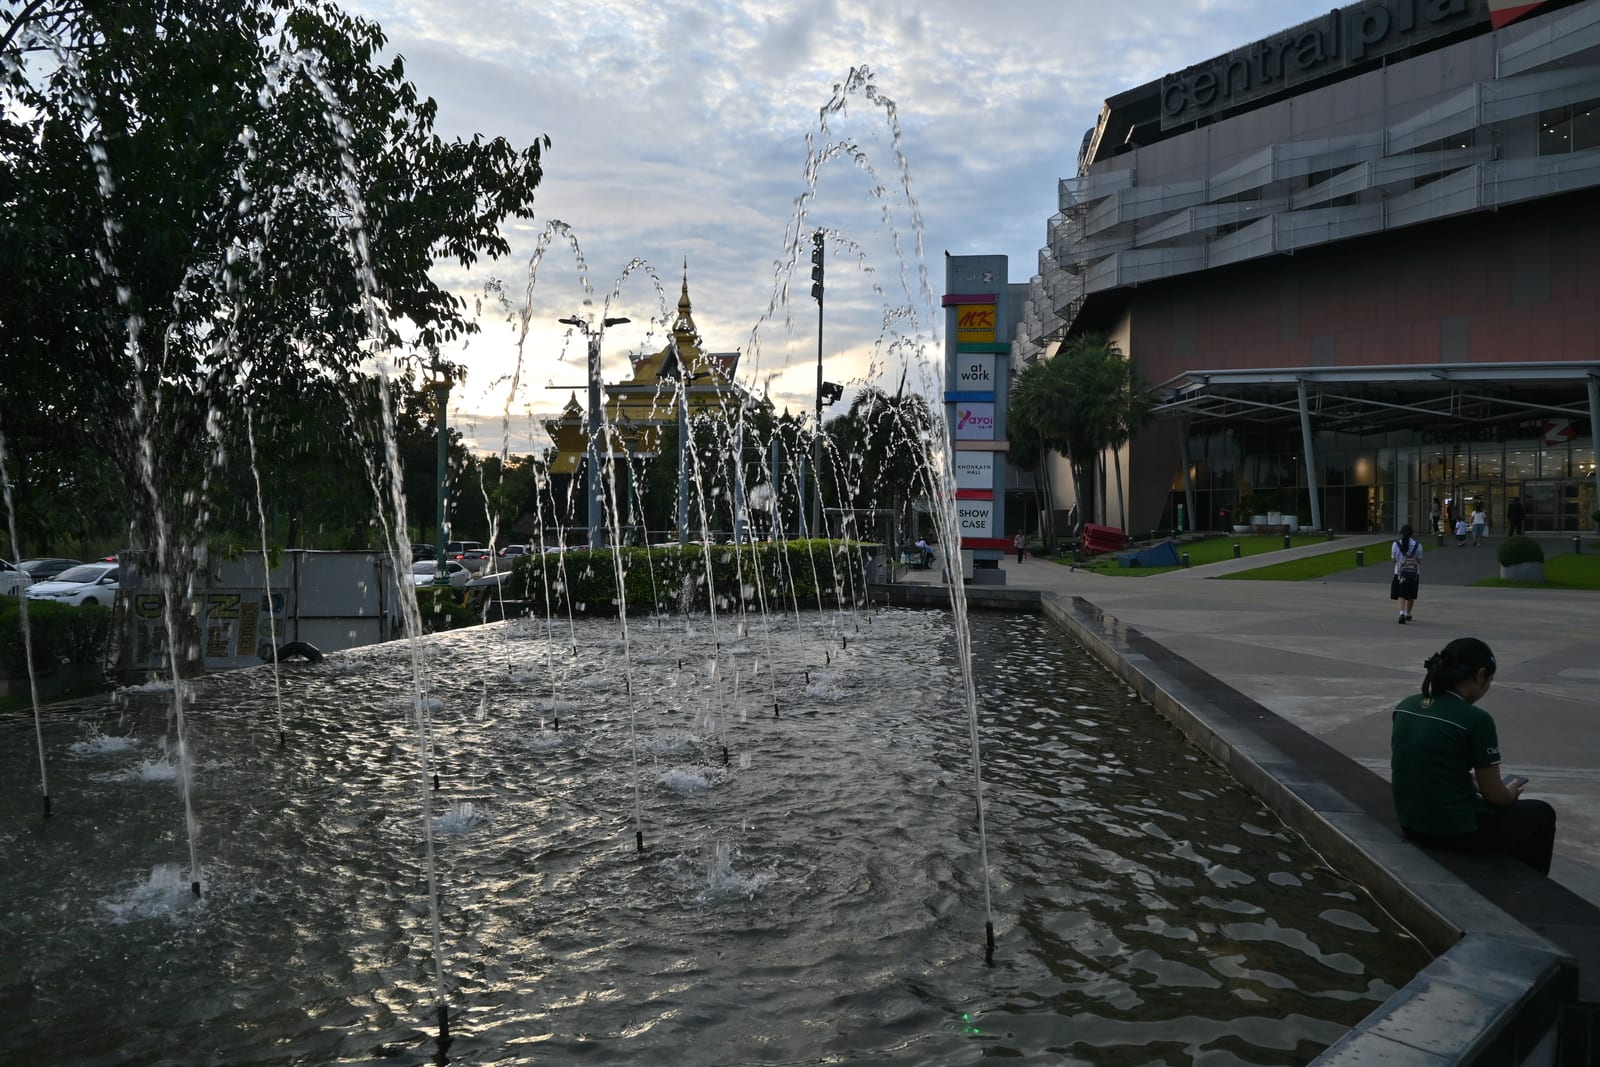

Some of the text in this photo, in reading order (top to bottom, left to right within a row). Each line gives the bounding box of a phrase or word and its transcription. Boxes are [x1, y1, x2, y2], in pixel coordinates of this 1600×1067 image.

[958, 311, 993, 326] MK
[970, 364, 983, 372] at
[961, 370, 990, 381] work
[959, 509, 989, 519] SHOW
[962, 520, 986, 529] CASE
